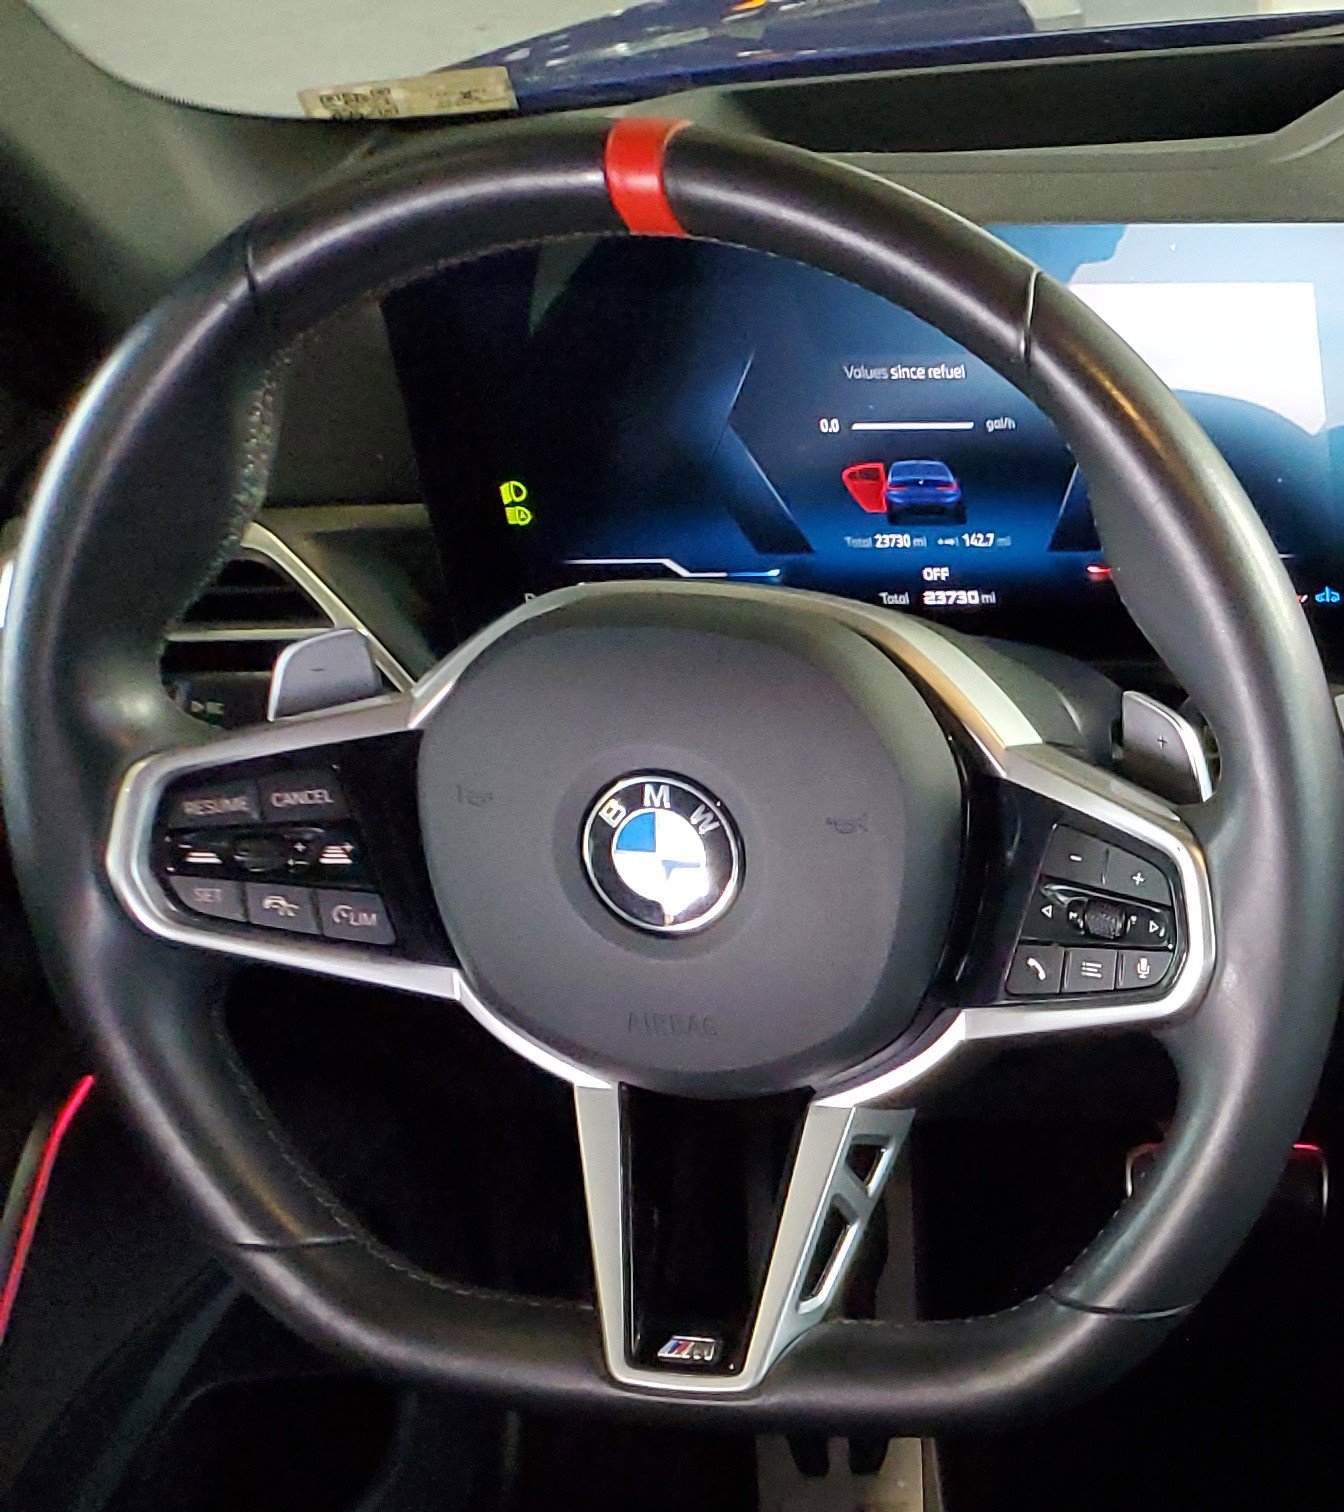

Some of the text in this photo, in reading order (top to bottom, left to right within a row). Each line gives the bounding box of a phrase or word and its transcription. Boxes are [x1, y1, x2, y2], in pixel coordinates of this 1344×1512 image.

[843, 364, 966, 379] Values since refuel
[819, 418, 840, 433] 0.0
[844, 535, 872, 548] Total
[874, 533, 911, 548] 23730
[962, 532, 995, 547] 142.7
[922, 567, 949, 581] OFF
[879, 590, 996, 605] Total 23730 mi
[271, 788, 334, 808] CANCEL
